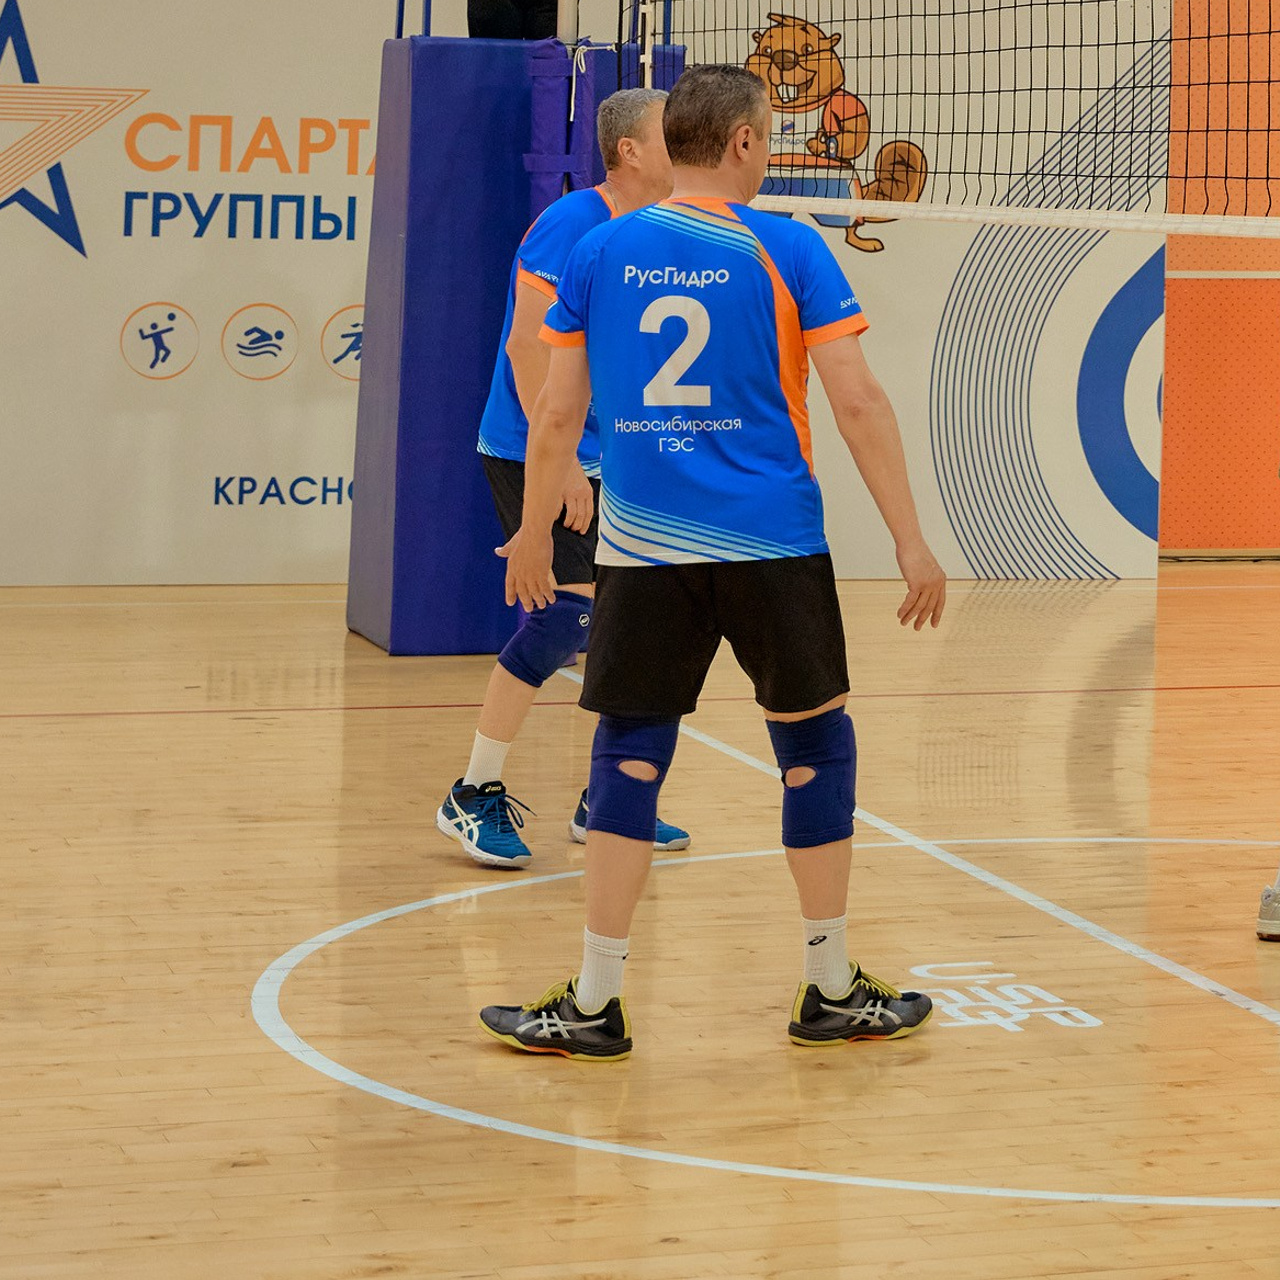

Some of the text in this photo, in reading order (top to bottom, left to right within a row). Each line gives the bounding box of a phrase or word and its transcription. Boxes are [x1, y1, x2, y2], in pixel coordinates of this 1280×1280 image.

[124, 112, 377, 176] СПАРТ
[123, 191, 357, 241] ГРУППЫ
[624, 265, 730, 288] РусГидро
[639, 295, 711, 407] 2
[615, 416, 742, 435] Новосибирская
[659, 437, 695, 453] ГЭС
